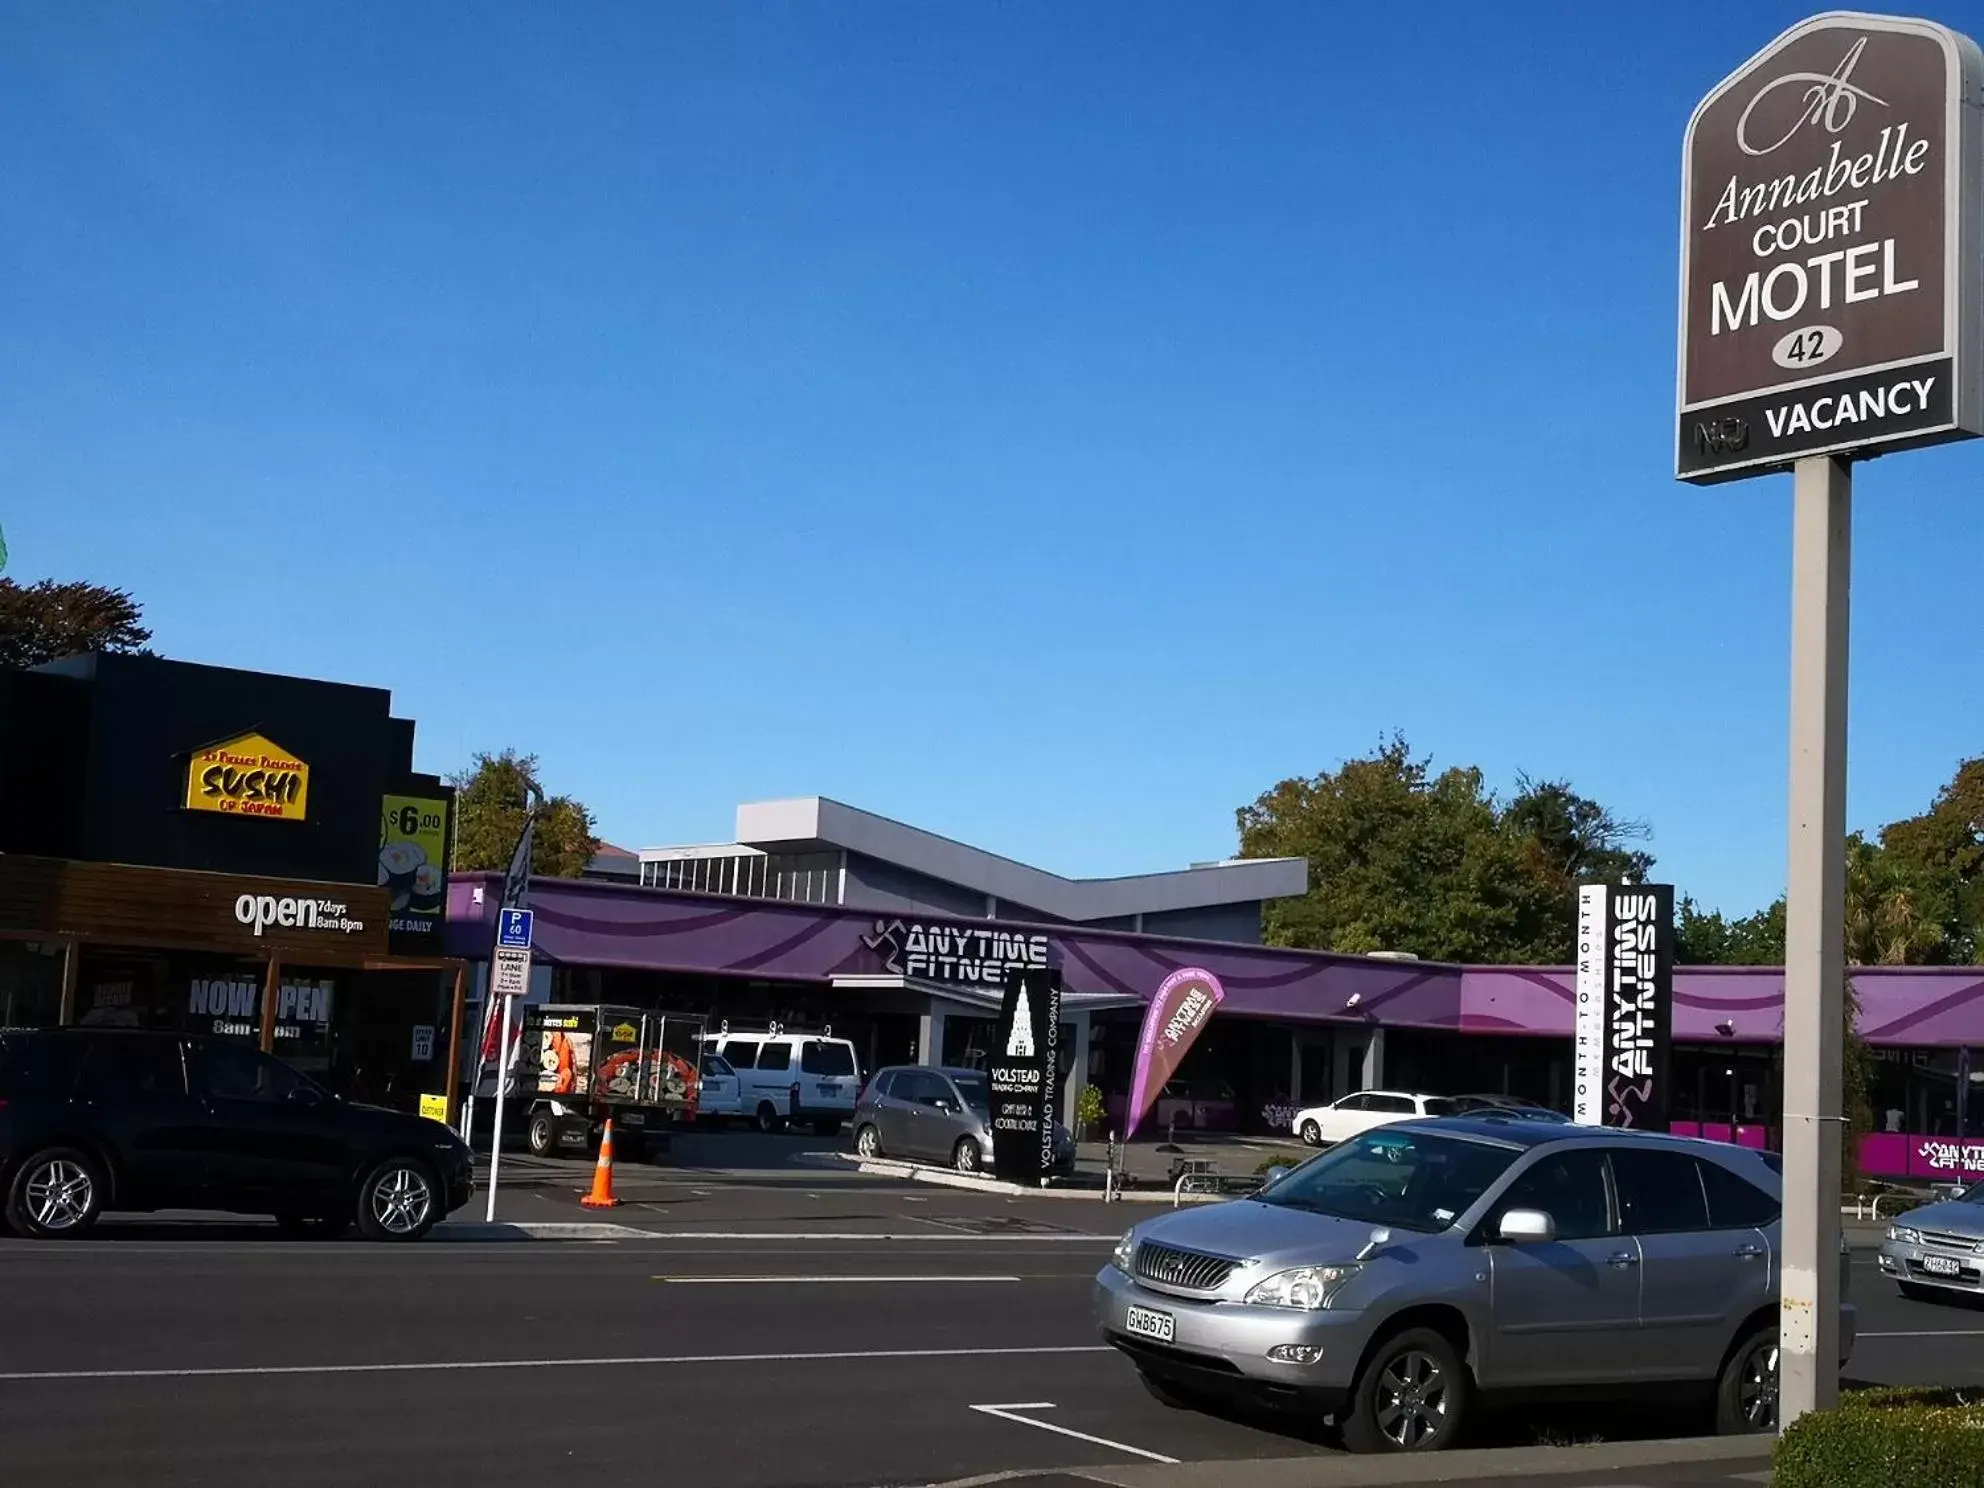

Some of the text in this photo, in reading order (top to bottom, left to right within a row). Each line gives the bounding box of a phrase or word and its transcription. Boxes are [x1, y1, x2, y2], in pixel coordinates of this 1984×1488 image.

[1703, 122, 1929, 230] Annabelle
[1752, 200, 1869, 257] COURT
[1711, 239, 1919, 336] MOTEL
[1787, 330, 1824, 362] 42
[1765, 377, 1936, 438] VACANCY
[201, 765, 301, 805] SUSHI
[240, 801, 283, 815] JAPAN
[389, 806, 441, 835] $6.00
[235, 894, 317, 936] open
[406, 920, 433, 933] DAILY
[509, 925, 522, 935] 60
[511, 912, 522, 925] P
[905, 924, 1048, 962] ANYTIME
[500, 963, 522, 972] LANE
[907, 954, 1047, 983] FITNE
[188, 979, 258, 1017] NOW
[1611, 894, 1638, 1079] ANYTIME
[1634, 894, 1657, 1076] FITNESS
[211, 1019, 250, 1036] 8am
[417, 1043, 428, 1056] 10
[991, 1068, 1040, 1083] VOLSTEAD
[1041, 987, 1060, 1169] VOLSTEAD TRADING COMPANY
[1129, 1310, 1171, 1337] GWB675
